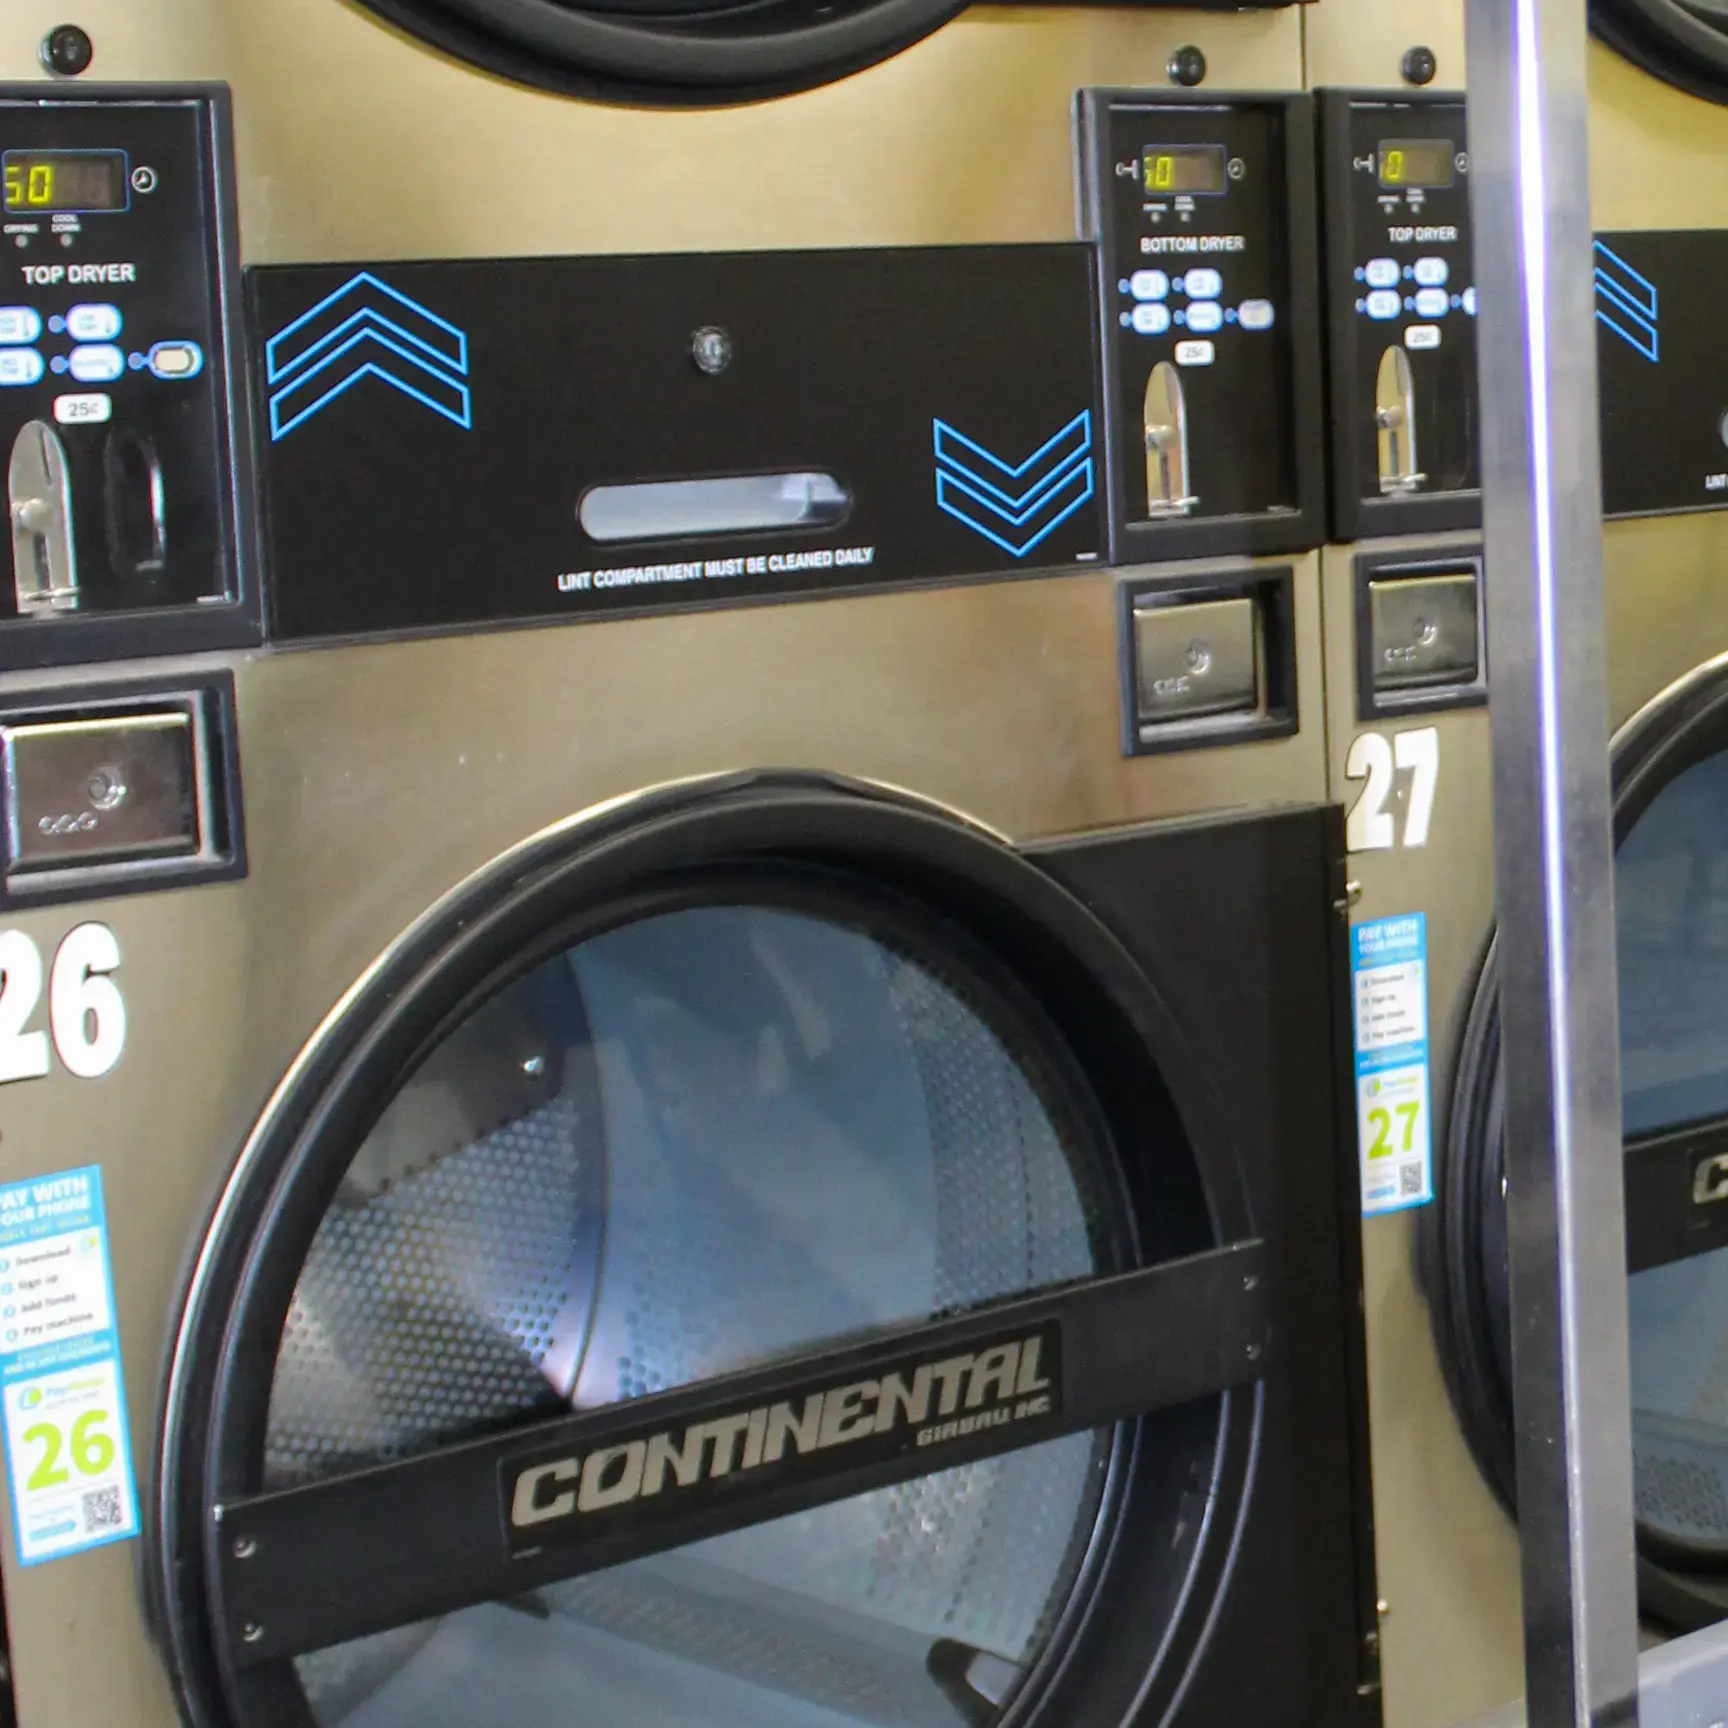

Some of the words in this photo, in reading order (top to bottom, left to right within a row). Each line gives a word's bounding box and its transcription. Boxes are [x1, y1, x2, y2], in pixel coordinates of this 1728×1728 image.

[1140, 236, 1198, 253] BOTTOM
[1199, 235, 1247, 252] DRYER
[1388, 227, 1415, 243] TOP
[1416, 225, 1459, 242] DRYER
[21, 264, 66, 286] TOP
[67, 262, 138, 285] DRYER
[557, 571, 592, 592] LINT
[593, 561, 704, 589] COMPARTMENT
[704, 556, 745, 578] MUST
[746, 555, 767, 573] BE
[768, 549, 833, 571] CLEANED
[835, 545, 875, 565] DAILY
[1346, 728, 1438, 853] 27
[0, 921, 126, 1086] 26
[1366, 1100, 1421, 1162] 27
[22, 1408, 116, 1491] 26
[512, 1335, 1051, 1527] CONTINENTAL
